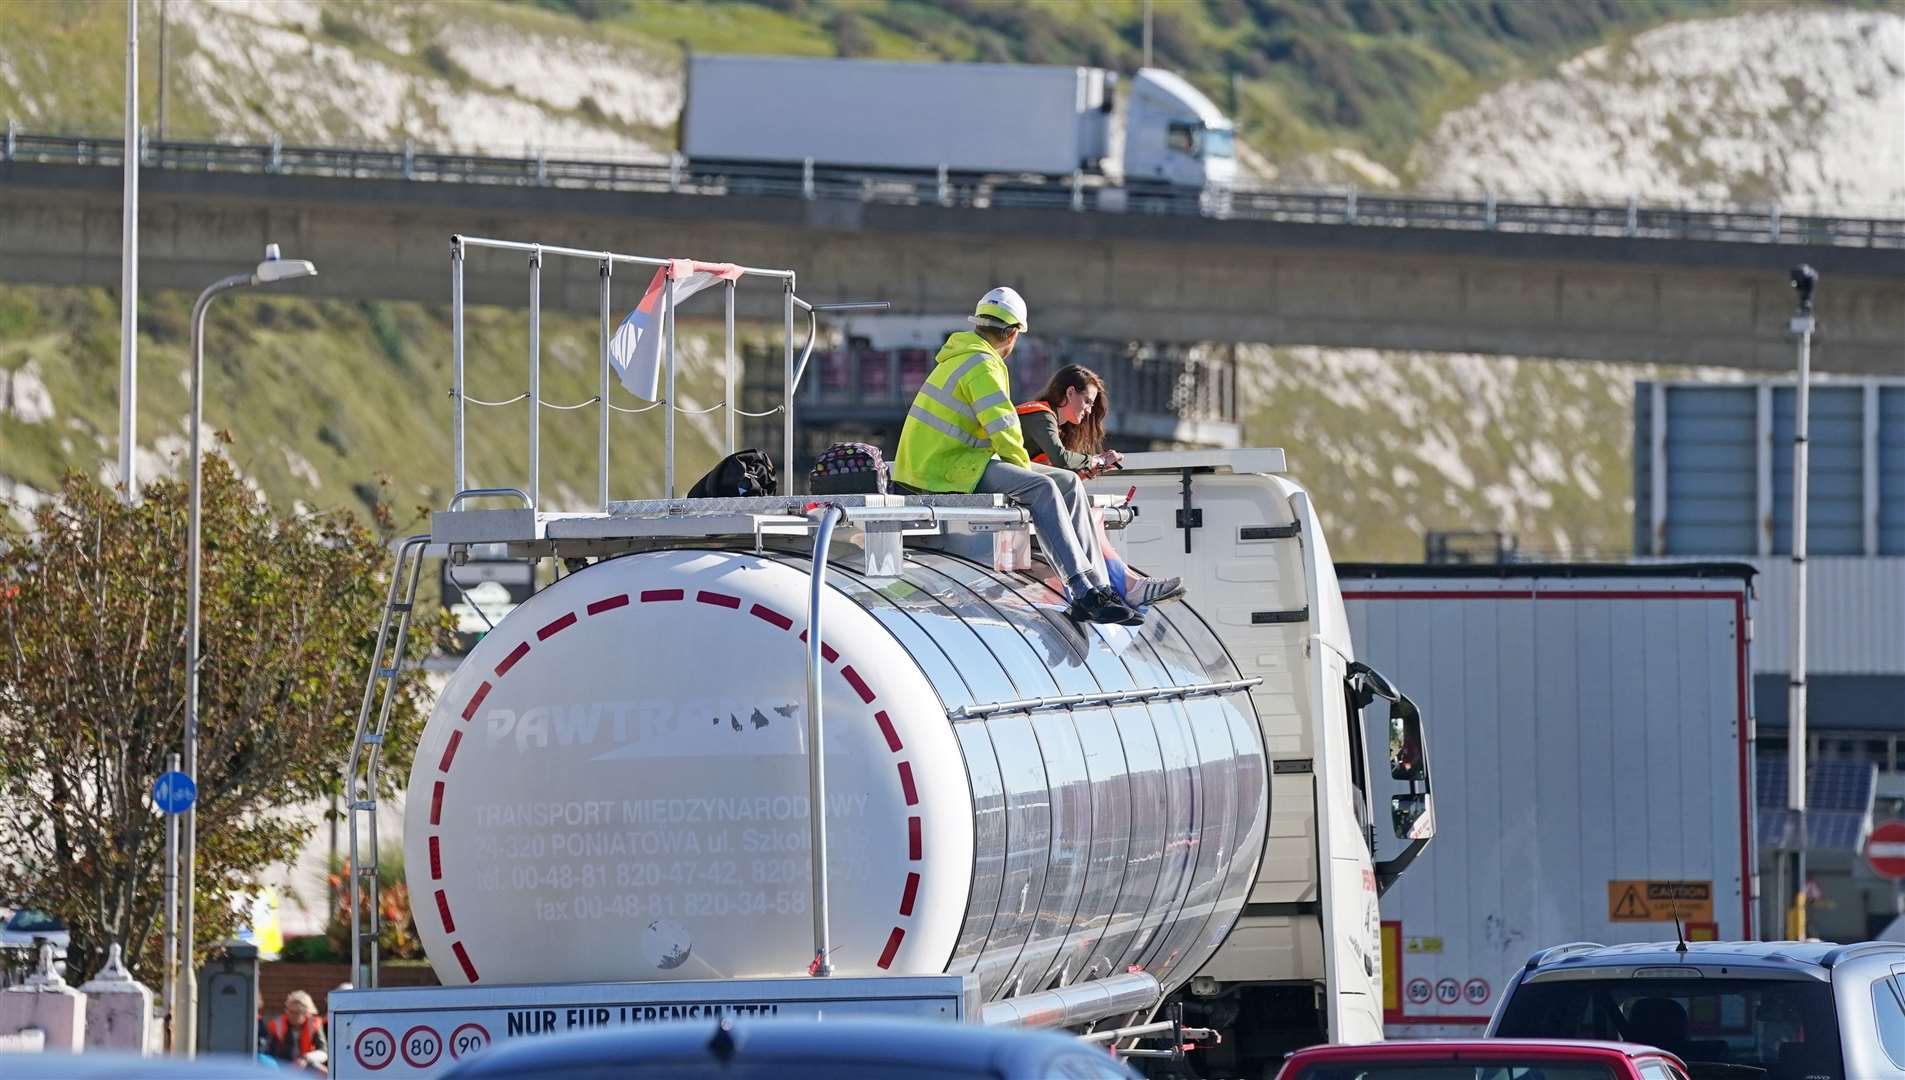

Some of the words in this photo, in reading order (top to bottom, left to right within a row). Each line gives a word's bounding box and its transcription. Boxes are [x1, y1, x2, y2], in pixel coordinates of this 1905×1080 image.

[473, 801, 616, 827] TRANSPORT
[622, 793, 867, 828] MIĘDZYNARODWY
[552, 830, 700, 857] PONIATOWA
[707, 827, 735, 853] ul.
[743, 825, 834, 853] Szkol
[511, 863, 606, 889] 00-48-81
[616, 858, 744, 890] 820-47-42,
[535, 896, 569, 920] fax
[573, 893, 673, 919] 00-48-81
[685, 890, 807, 917] 820-34-58
[1440, 985, 1456, 997] 70
[507, 1010, 556, 1037] NUR
[364, 1039, 386, 1057] 50
[411, 1038, 434, 1056] 80
[459, 1036, 481, 1055] 90
